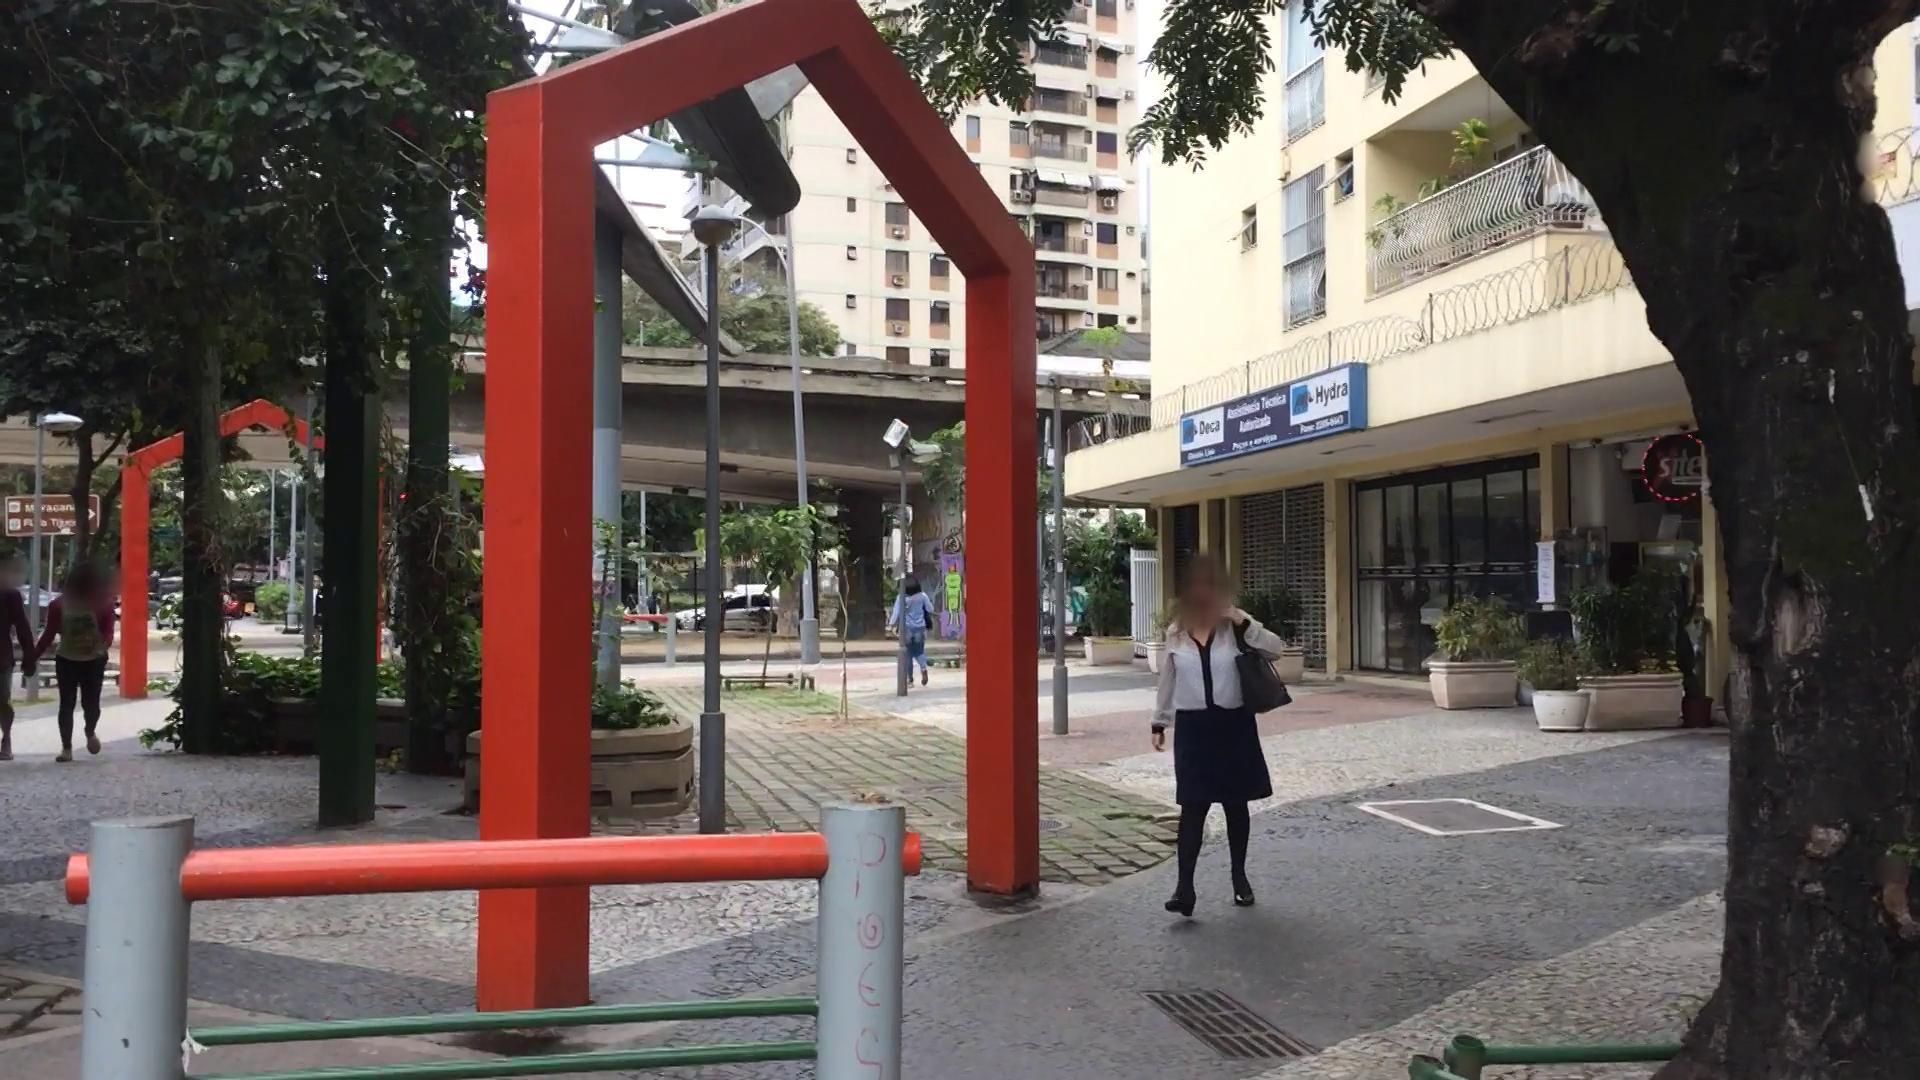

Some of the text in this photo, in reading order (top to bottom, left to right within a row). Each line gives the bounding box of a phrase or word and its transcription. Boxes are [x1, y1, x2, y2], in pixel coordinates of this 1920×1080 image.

[1316, 382, 1348, 406] Hydra
[1199, 419, 1220, 435] Deca
[24, 504, 76, 513] Mracan
